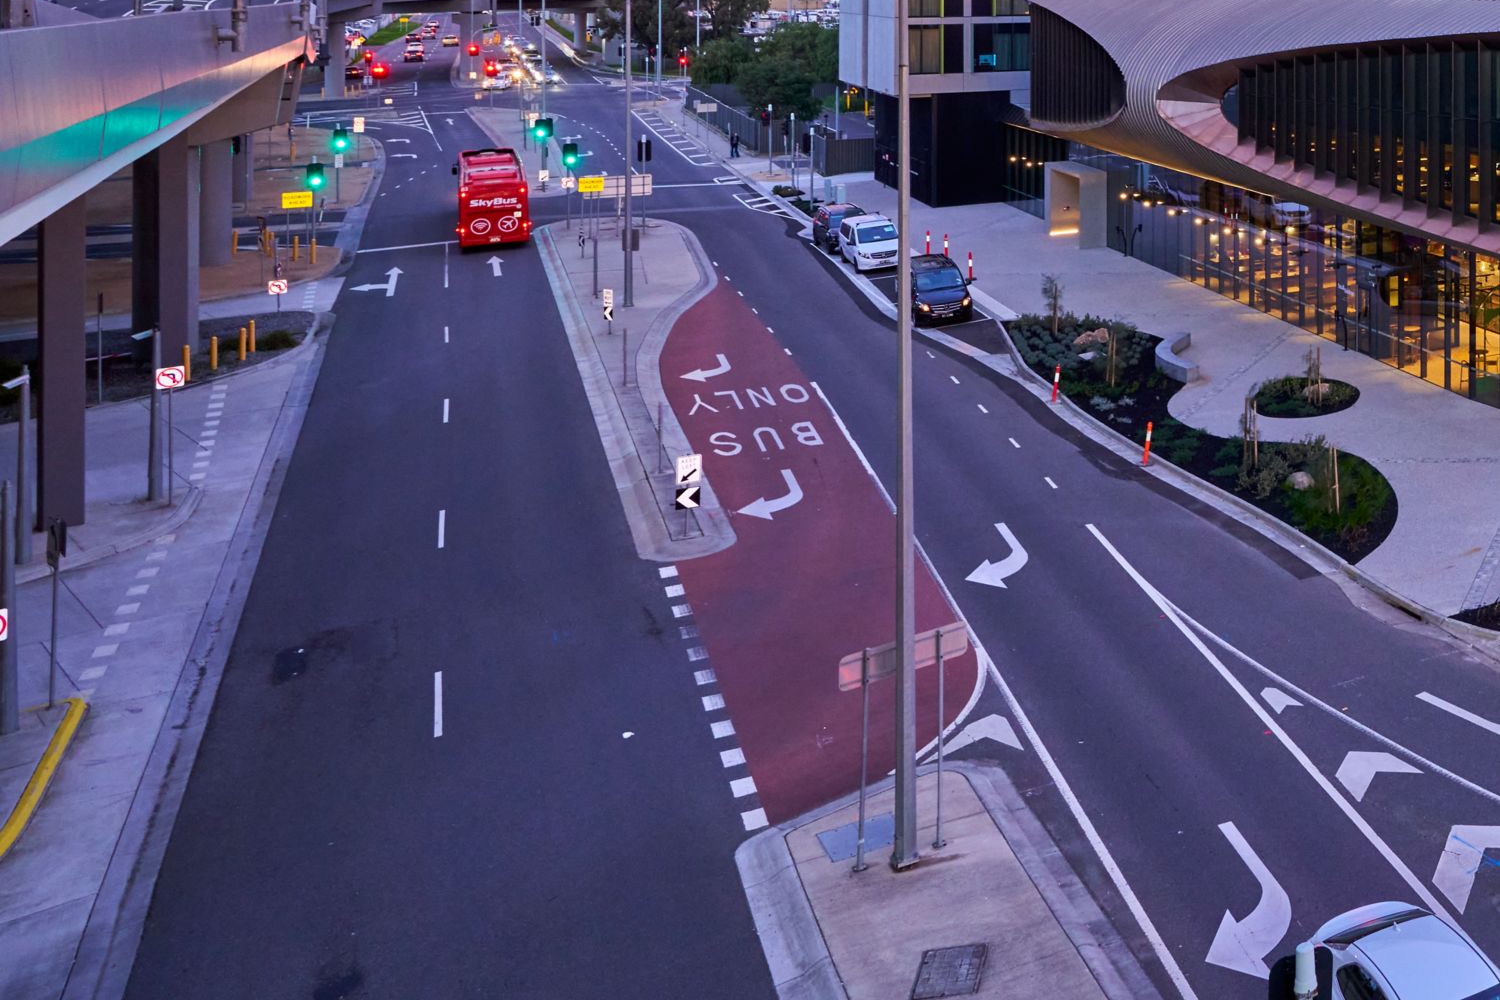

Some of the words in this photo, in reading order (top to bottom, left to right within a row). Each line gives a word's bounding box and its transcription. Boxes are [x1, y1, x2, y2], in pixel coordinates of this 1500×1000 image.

[469, 197, 518, 208] SkyBus
[688, 383, 811, 416] ONLY
[708, 420, 825, 457] BUS
